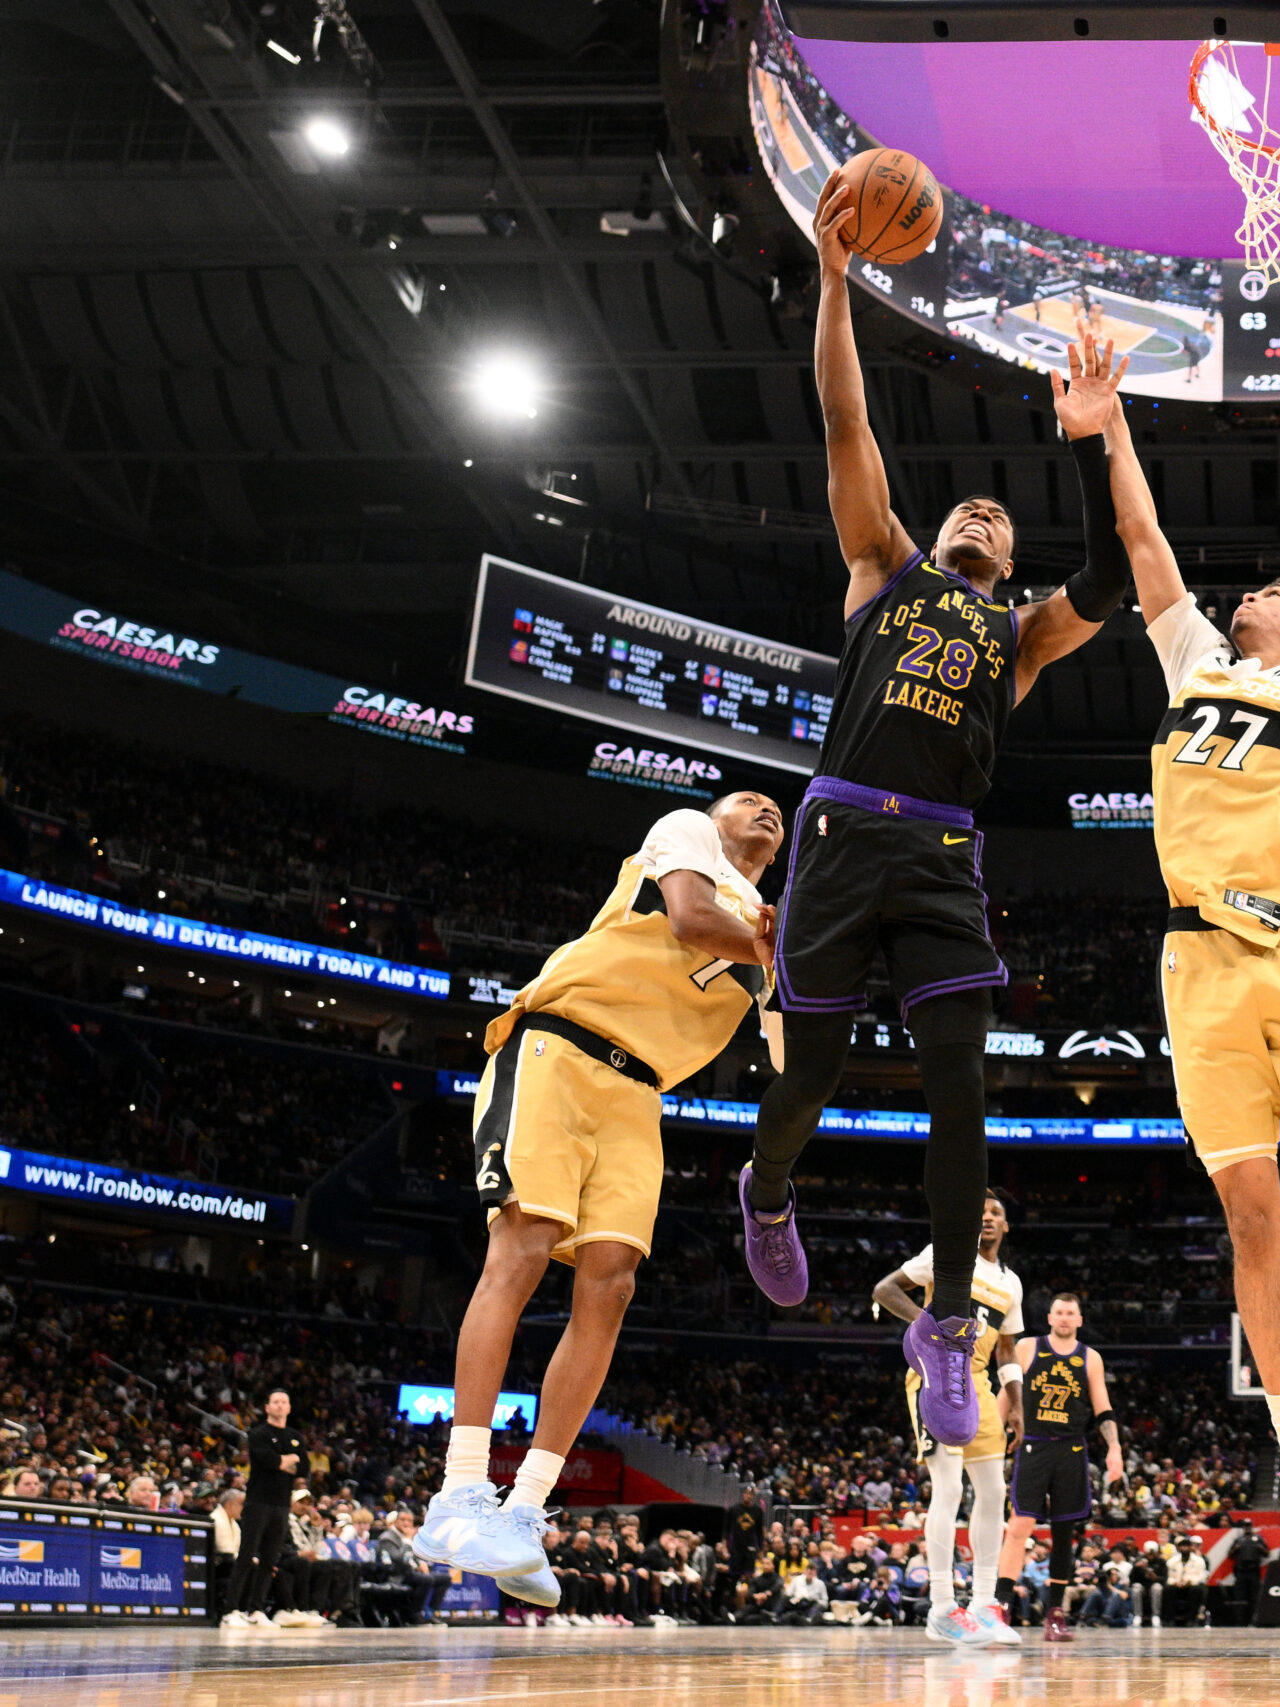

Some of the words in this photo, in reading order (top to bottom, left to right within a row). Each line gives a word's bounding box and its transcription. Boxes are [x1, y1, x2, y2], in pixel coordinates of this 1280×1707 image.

[1239, 312, 1267, 331] 63
[57, 622, 184, 669] SPORTSBOOK
[73, 608, 220, 664] CAESARS
[607, 604, 691, 641] AROUND
[694, 630, 730, 653] THE
[732, 640, 804, 673] LEAGUE
[877, 599, 926, 636] LOS
[936, 590, 1005, 679] ANGELES
[896, 621, 978, 690] 28
[334, 700, 445, 739] SPORTSBOOK
[343, 686, 474, 733] CAESARS
[883, 680, 964, 726] LAKERS
[1172, 705, 1270, 771] 27
[590, 757, 696, 787] SPORTSBOOK
[595, 743, 722, 780] CAESARS
[883, 796, 900, 814] LAL
[22, 884, 98, 921] LAUNCH
[101, 906, 150, 934] YOUR
[153, 921, 175, 940] AI
[179, 926, 313, 968] DEVELOPMENT
[316, 953, 374, 979] TODAY
[378, 967, 414, 987] AND
[25, 1164, 267, 1222] www.ironbow.com/dell
[1031, 1371, 1048, 1391] LOS
[1039, 1384, 1072, 1410] 77
[1036, 1409, 1069, 1424] LAKERS
[44, 1567, 80, 1587] Health
[101, 1570, 139, 1591] MedStar
[140, 1573, 171, 1592] Health
